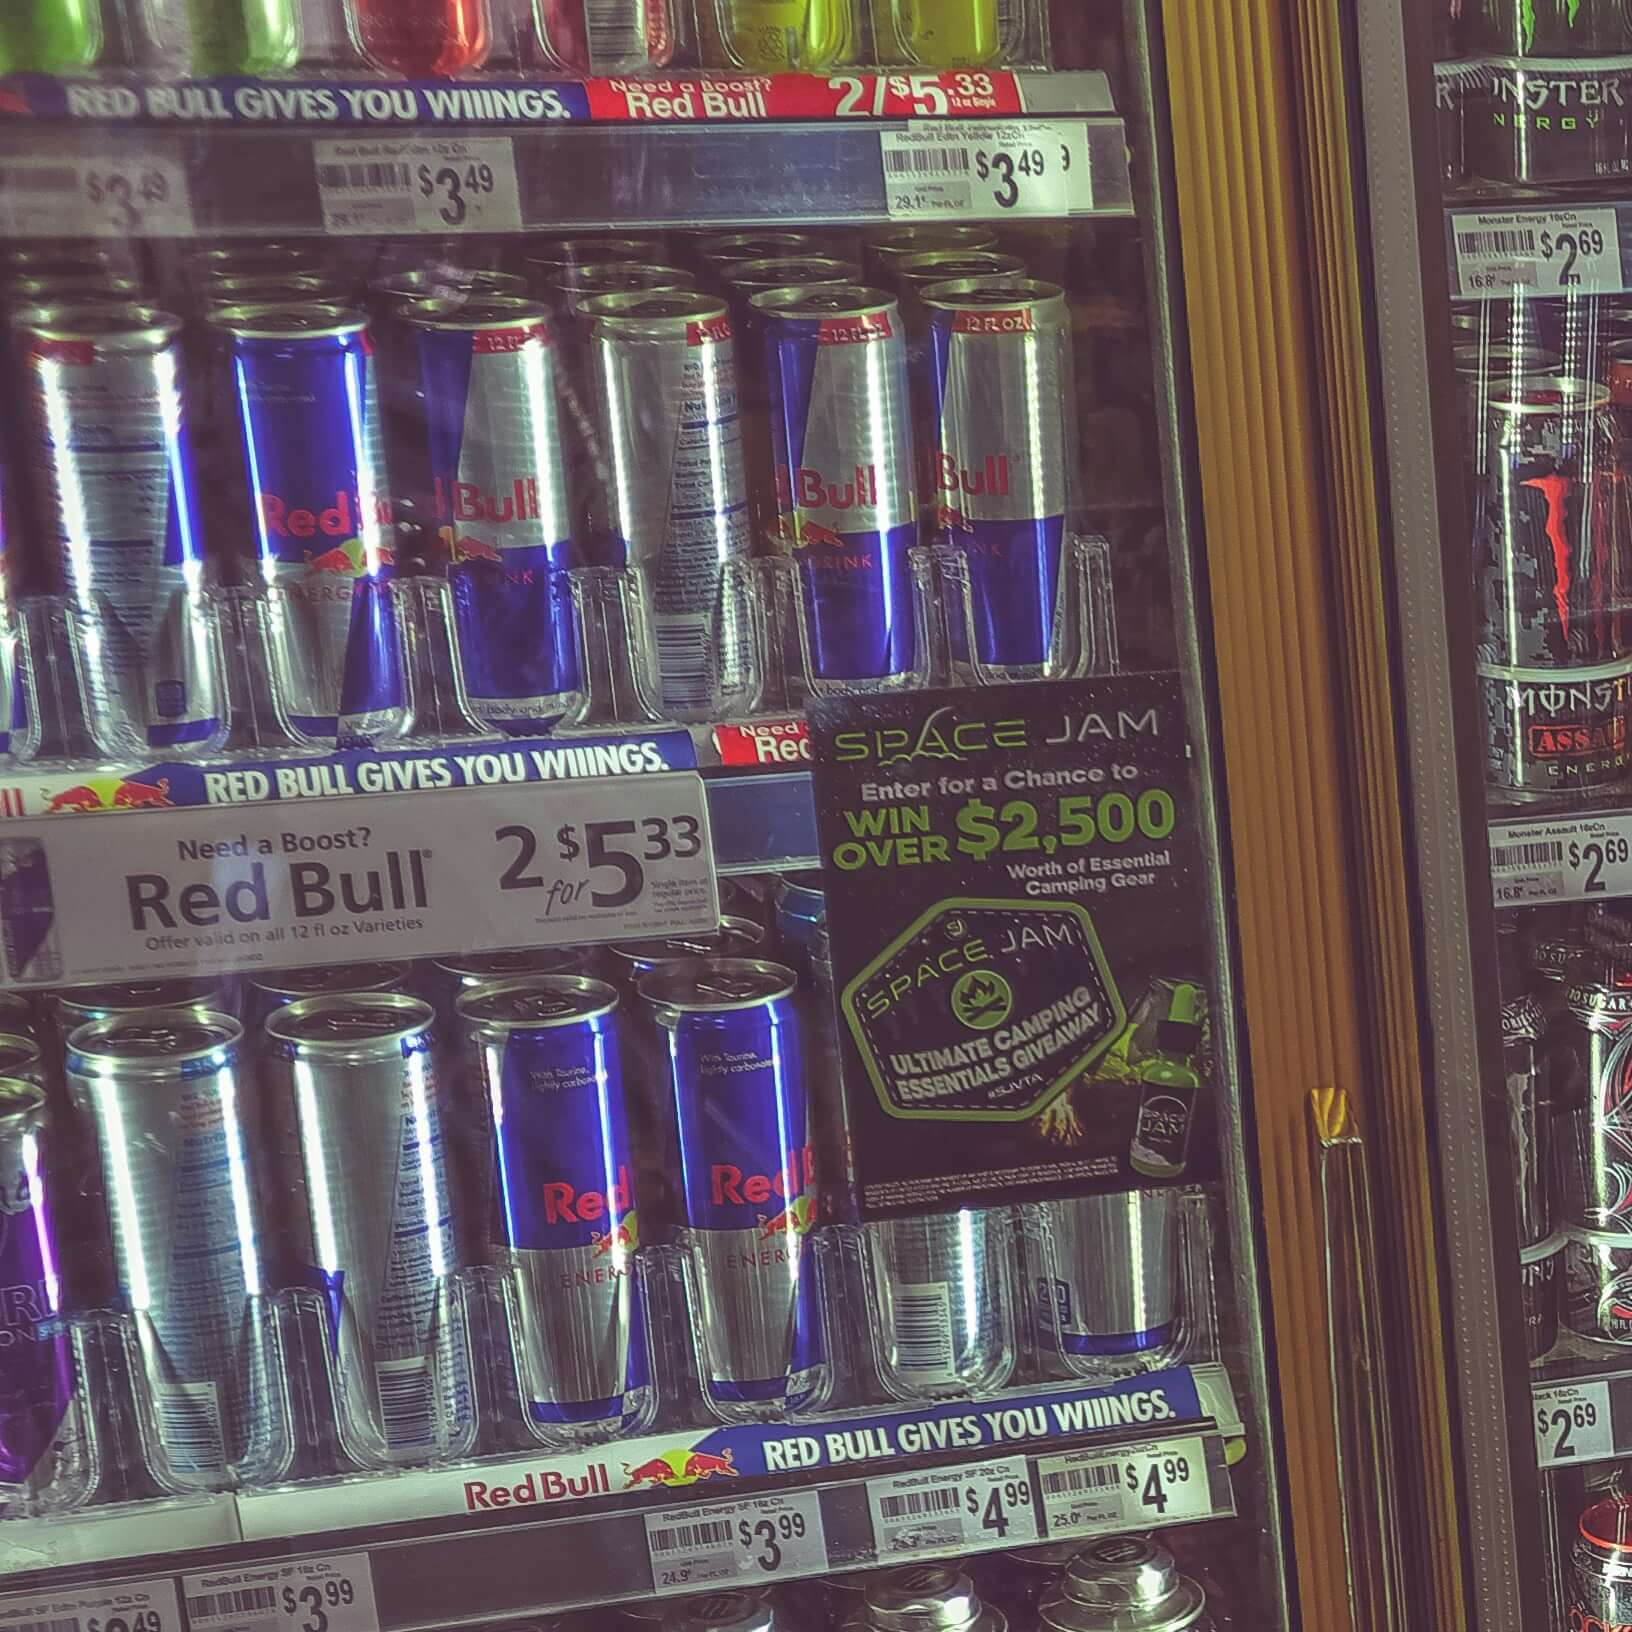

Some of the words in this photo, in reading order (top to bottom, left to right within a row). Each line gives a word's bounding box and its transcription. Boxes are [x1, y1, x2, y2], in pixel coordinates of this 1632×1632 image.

[66, 86, 140, 118] RED
[144, 87, 231, 120] BULL
[236, 88, 338, 120] GIVES
[341, 90, 417, 120] YOU
[423, 89, 571, 119] WIIINGS.
[610, 79, 677, 93] Need
[683, 82, 694, 92] a
[700, 78, 772, 92] Boost?
[627, 92, 694, 118] Red
[702, 92, 767, 118] Bull
[801, 464, 878, 510] Bull
[937, 452, 1010, 495] Bull
[261, 492, 349, 537] Red
[455, 478, 539, 522] Bull
[740, 723, 801, 738] Need
[834, 707, 1027, 766] SPACE
[1046, 709, 1159, 745] JAM
[207, 772, 273, 803] RED
[279, 764, 353, 797] BULL
[358, 758, 451, 793] GIVES
[458, 752, 525, 783] YOU
[532, 742, 668, 779] WIIINGS.
[861, 780, 932, 801] Enter
[938, 778, 975, 795] for
[982, 777, 997, 791] a
[1003, 767, 1104, 790] Chance
[1111, 764, 1138, 781] to
[178, 836, 249, 860] Need
[257, 835, 272, 854] a
[281, 826, 372, 852] Boost?
[833, 837, 951, 870] OVER
[955, 788, 1176, 861] $2,500
[846, 804, 931, 838] WIN
[495, 825, 544, 889] 2
[546, 879, 589, 915] for
[1007, 861, 1062, 880] Worth
[1067, 859, 1085, 874] of
[1090, 851, 1170, 872] Essential
[1025, 876, 1106, 896] Camping
[1111, 871, 1154, 888] Gear
[126, 861, 270, 929] Red
[290, 849, 432, 914] Bull
[145, 934, 188, 952] Offer
[196, 930, 233, 949] valid
[241, 928, 262, 944] on
[268, 925, 287, 942] all
[293, 924, 309, 939] 12
[334, 923, 349, 937] oz
[353, 916, 423, 936] Varieties
[867, 939, 988, 1019] SPACE
[1001, 924, 1073, 954] JAM
[890, 1030, 991, 1075] ULTIMATE
[993, 986, 1091, 1049] CAMPING
[897, 1048, 1008, 1102] ESSENTIALS
[1012, 1001, 1101, 1071] GIVEAWAY
[542, 1168, 634, 1225] Red
[712, 1157, 794, 1205] Red
[764, 1438, 822, 1471] RED
[827, 1429, 895, 1461] BULL
[899, 1416, 982, 1453] GIVES
[988, 1406, 1048, 1438] YOU
[1053, 1391, 1176, 1430] WIIINGS.
[464, 1478, 536, 1512] Red
[541, 1464, 610, 1500] Bull
